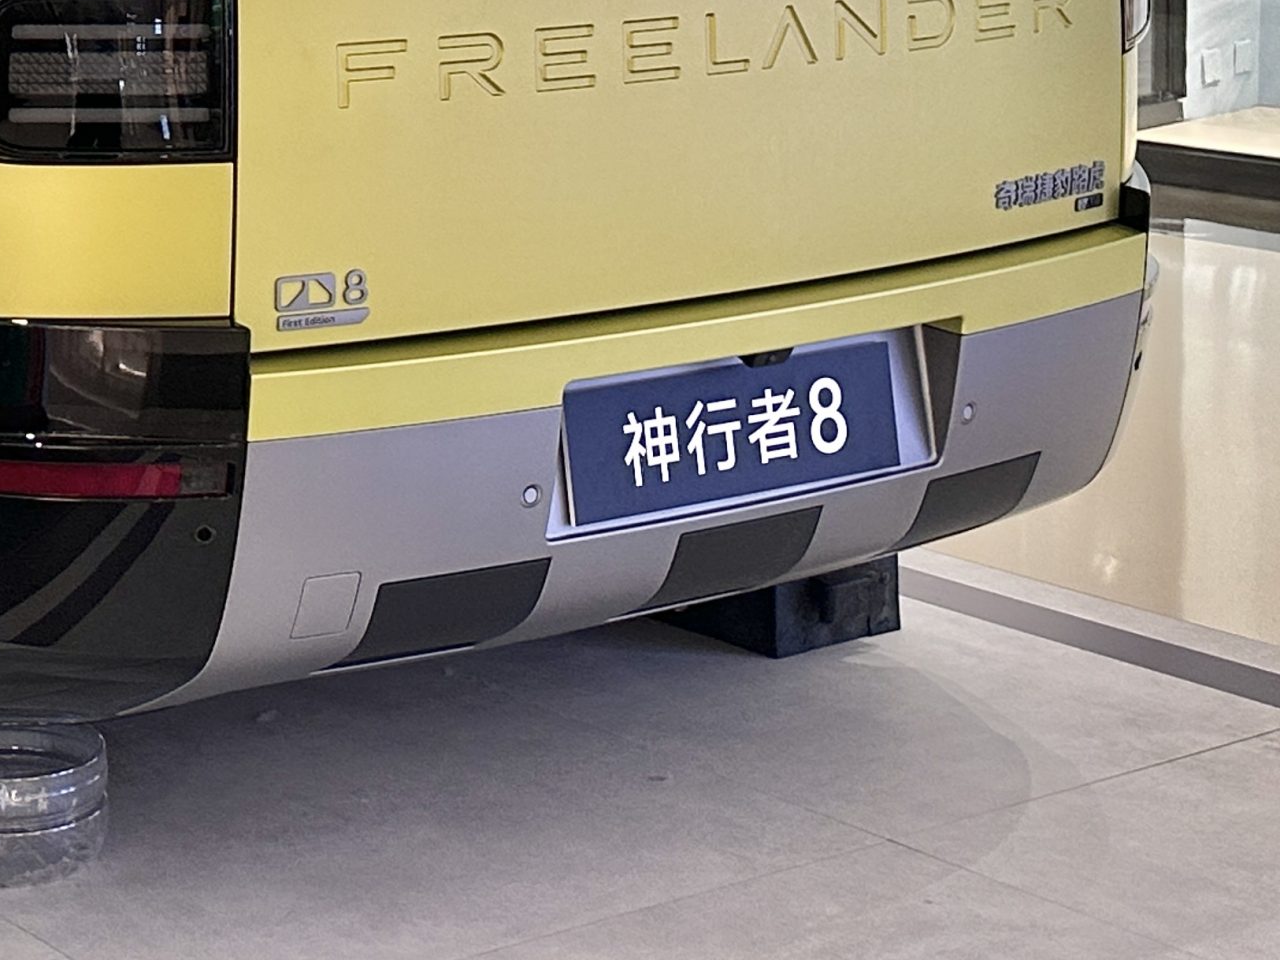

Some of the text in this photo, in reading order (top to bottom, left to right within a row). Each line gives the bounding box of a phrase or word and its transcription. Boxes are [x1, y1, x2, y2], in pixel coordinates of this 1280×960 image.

[995, 161, 1105, 210] 奇瑞捷豹路虎
[343, 268, 368, 305] 8
[282, 315, 335, 329] First Edition
[625, 377, 849, 487] 神行者8
